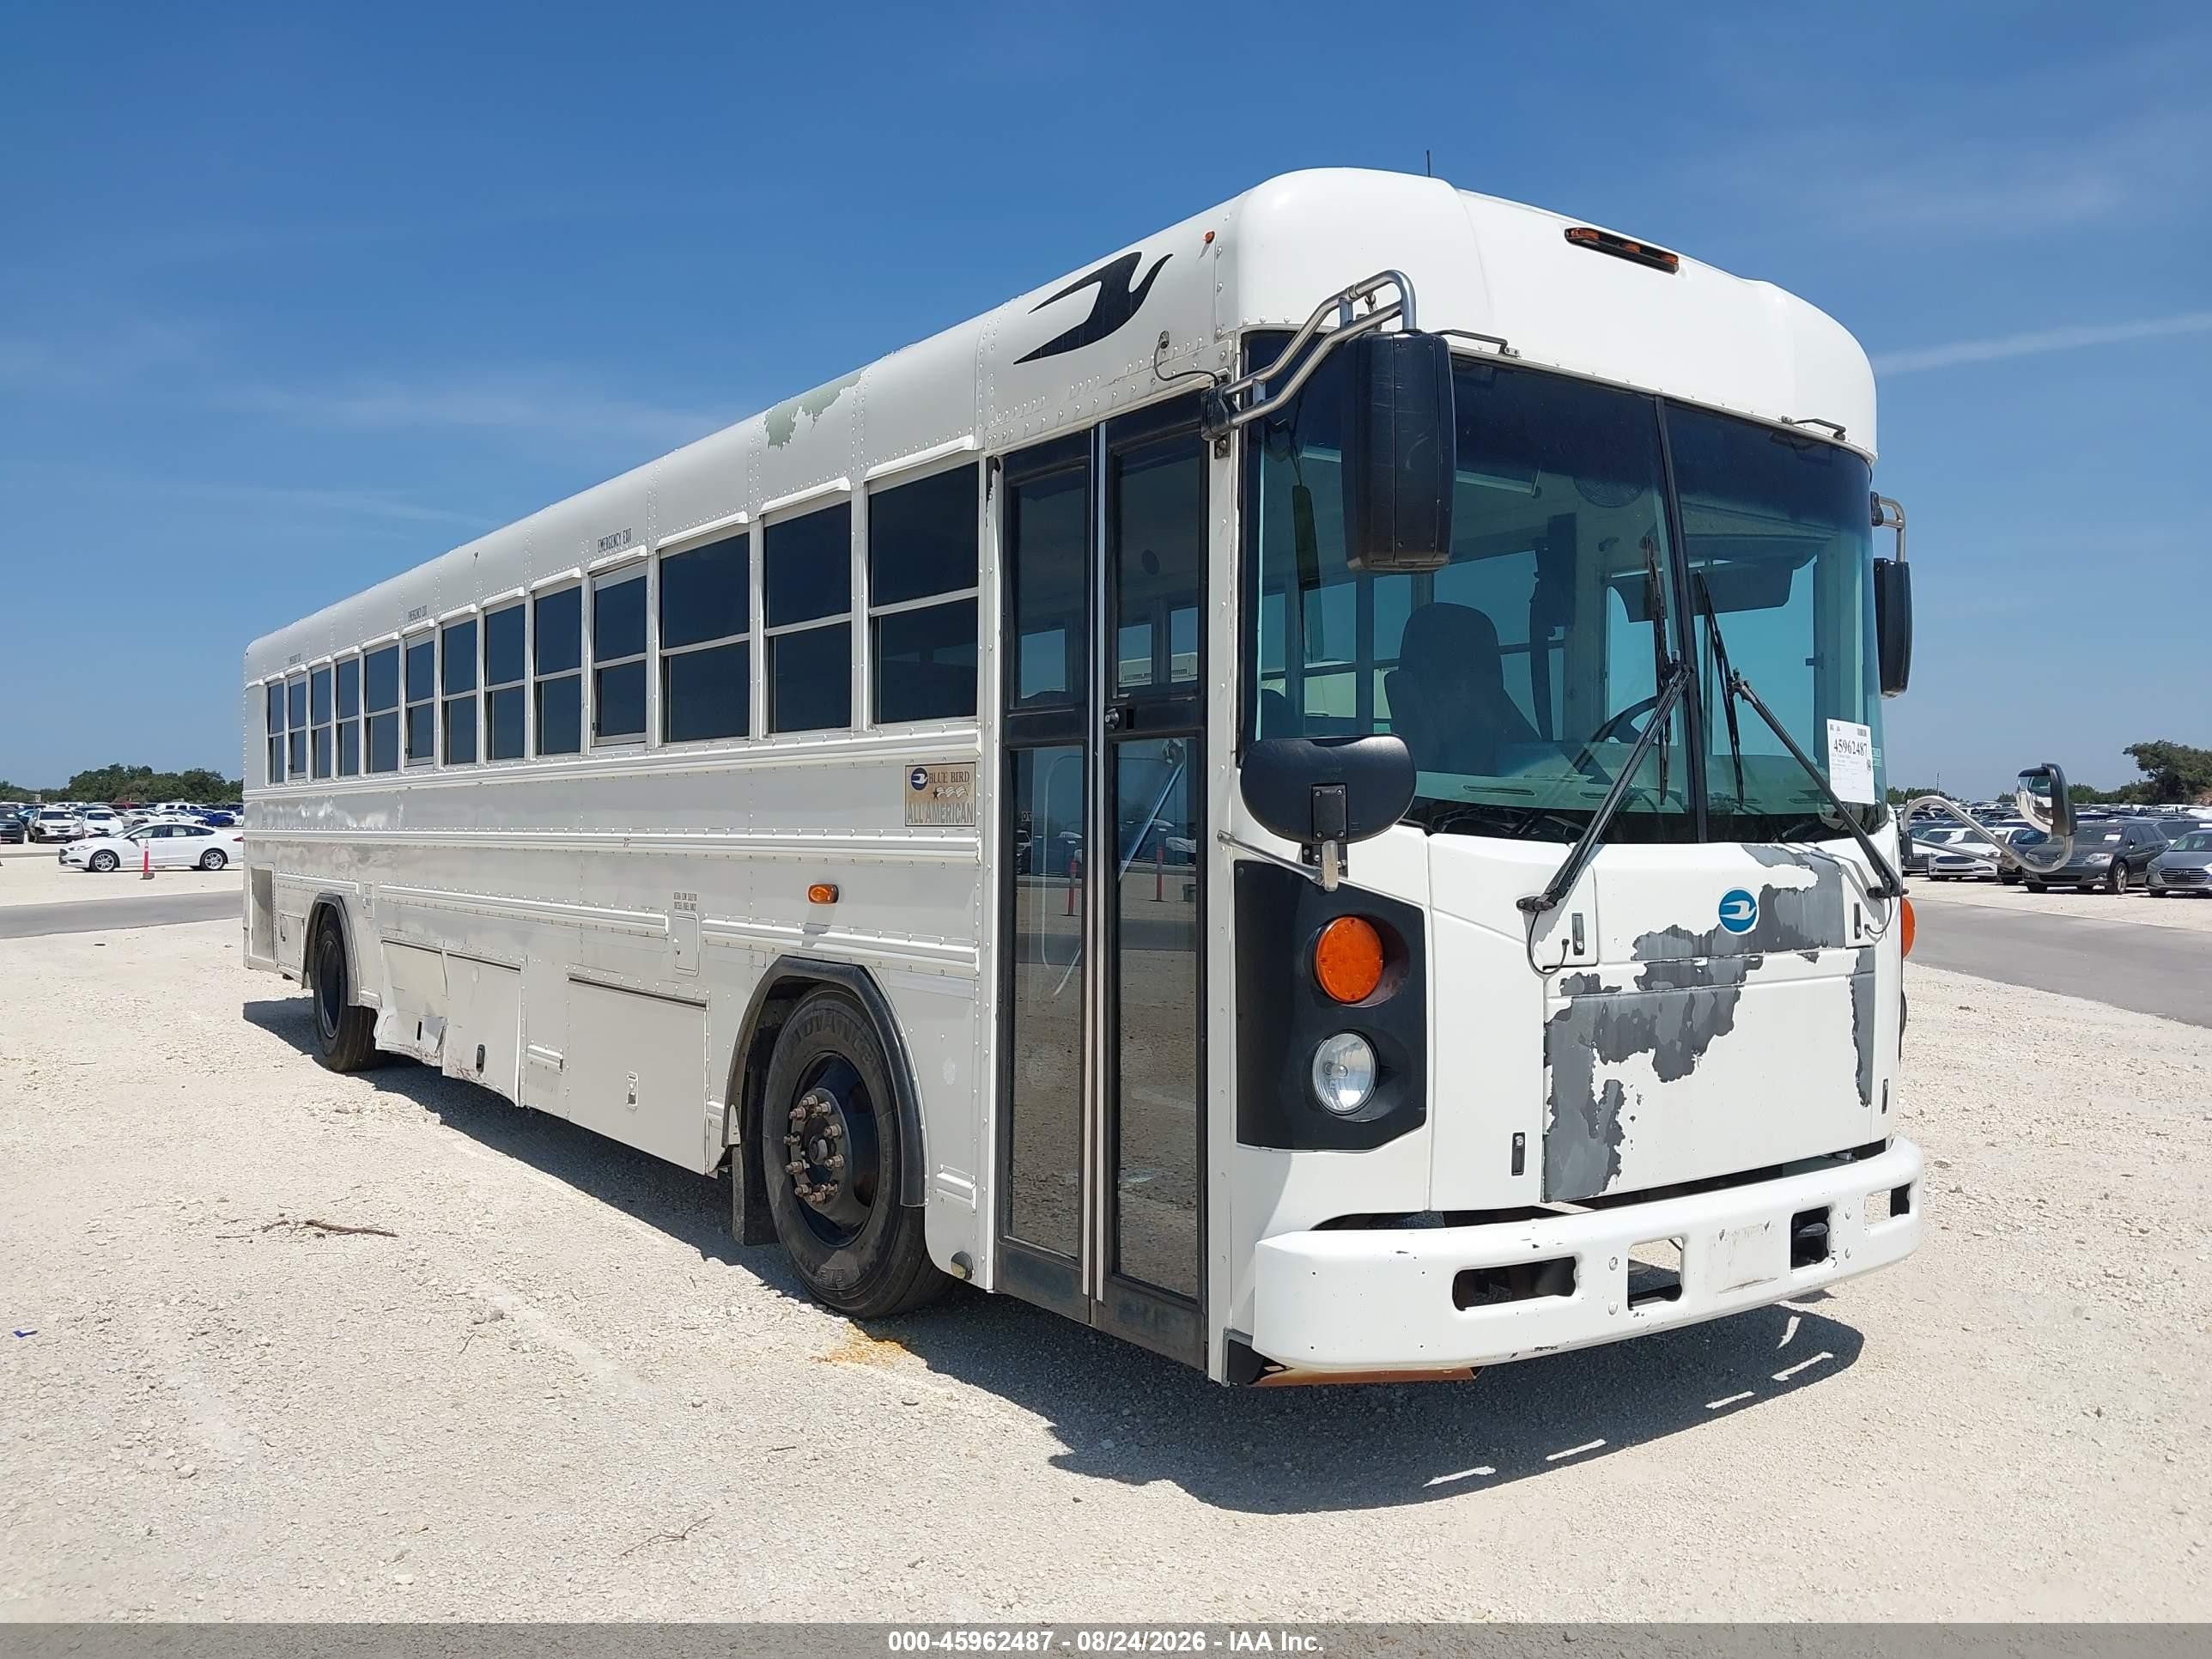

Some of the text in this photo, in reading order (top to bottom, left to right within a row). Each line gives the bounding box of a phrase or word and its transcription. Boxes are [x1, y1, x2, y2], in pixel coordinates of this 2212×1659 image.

[598, 531, 622, 553] EMERGENCY
[1833, 738, 1868, 757] 45962487
[928, 770, 970, 784] BLUE BIRD
[907, 800, 974, 824] ALL AMERICAN
